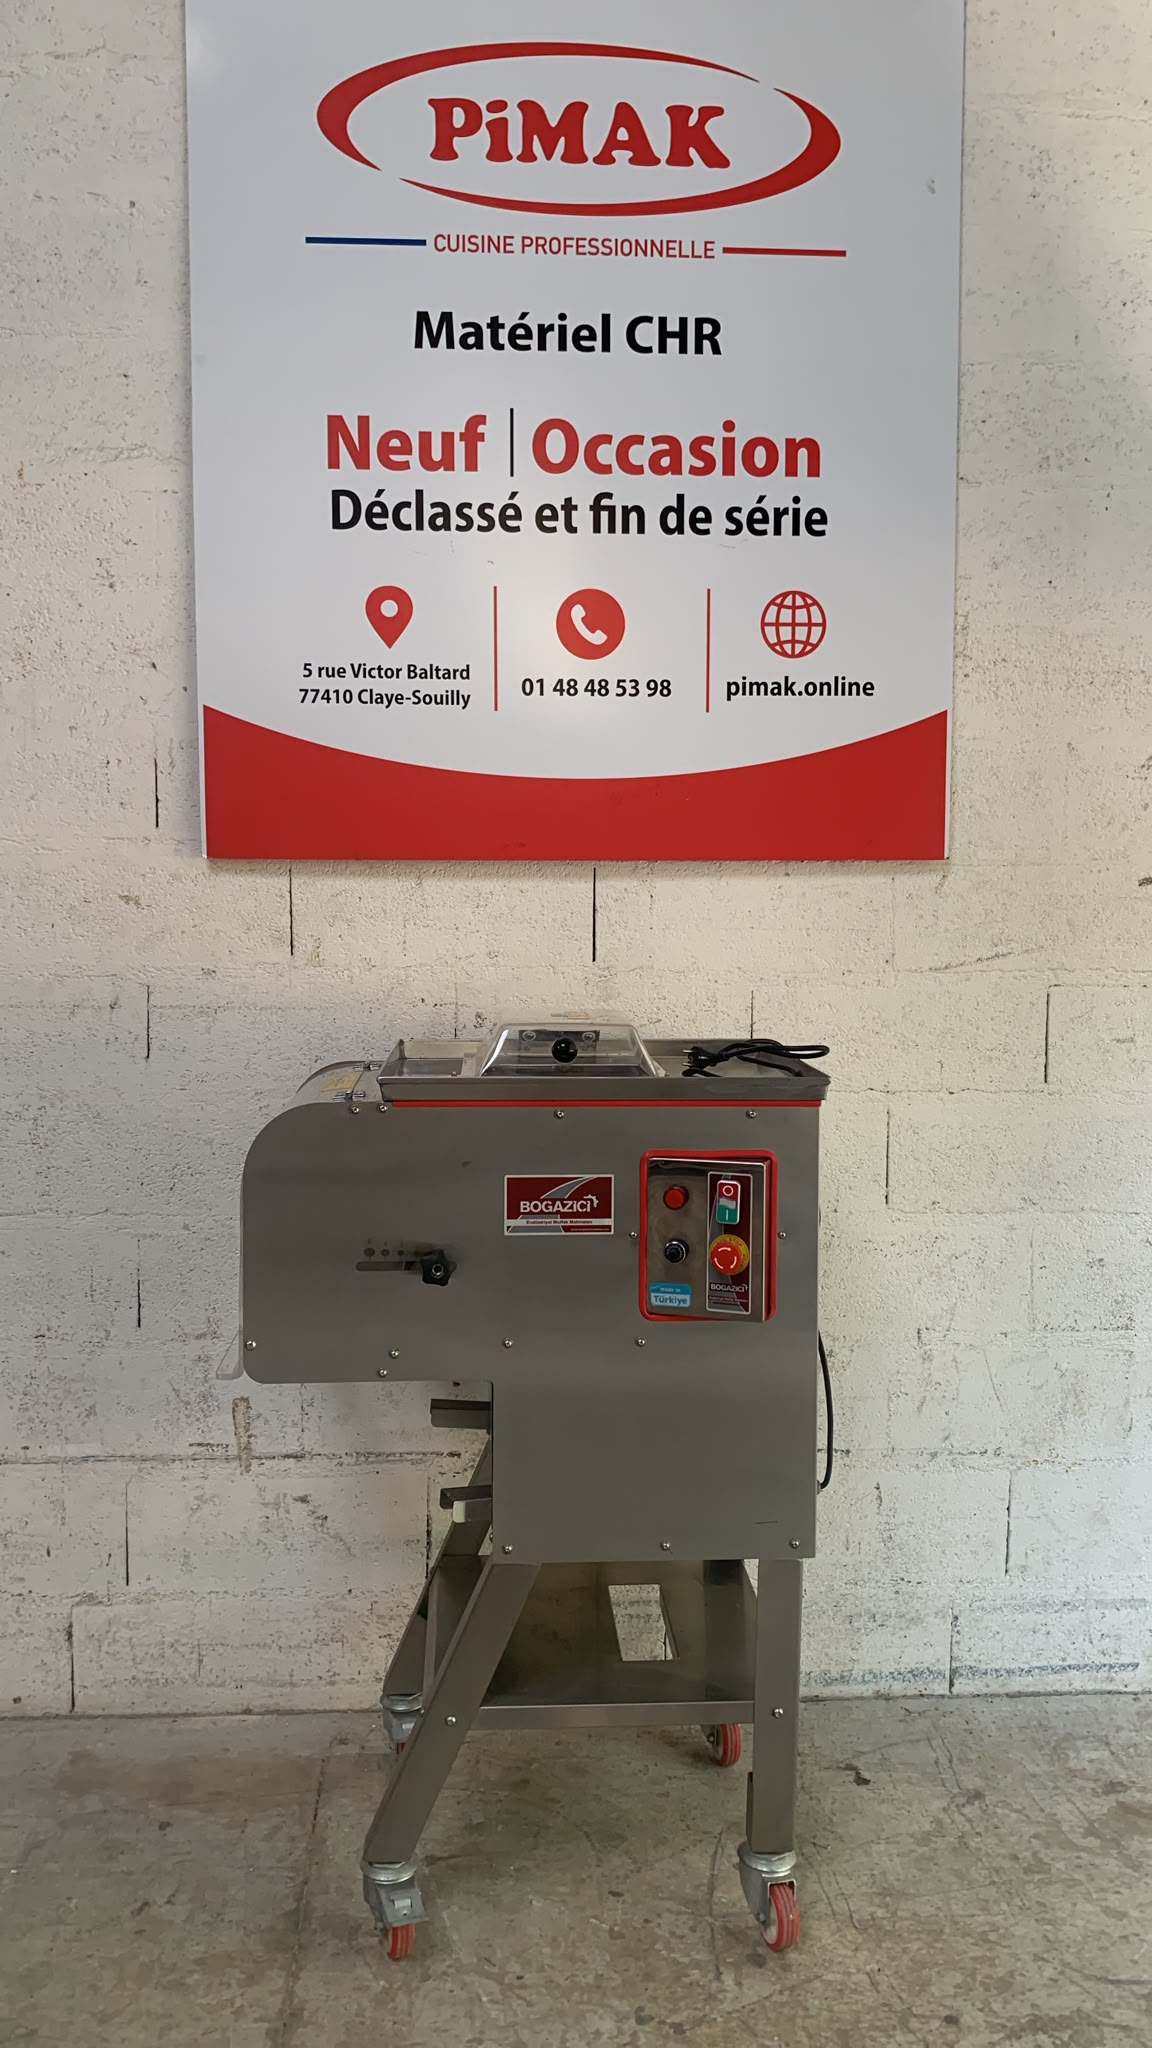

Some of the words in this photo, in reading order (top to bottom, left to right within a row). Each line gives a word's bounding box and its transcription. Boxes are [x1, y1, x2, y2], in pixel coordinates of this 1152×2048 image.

[433, 234, 515, 254] CUISINE
[521, 235, 716, 259] PROFESSIONNELLE
[414, 311, 611, 353] Matériel
[625, 316, 722, 356] CHR
[327, 414, 487, 473] Neuf
[531, 419, 821, 478] Occasion
[331, 489, 523, 533] Déclassé
[534, 497, 579, 534] et
[589, 492, 646, 535] fin
[659, 494, 713, 536] de
[724, 495, 828, 538] série
[302, 663, 313, 678] 5
[317, 667, 347, 679] rue
[350, 663, 403, 680] Victor
[407, 664, 470, 681] Baltard
[298, 688, 353, 705] 77410
[357, 688, 471, 710] Claye-Souilly
[521, 678, 544, 697] 01
[552, 678, 579, 697] 48
[583, 678, 610, 697] 48
[615, 678, 640, 698] 53
[645, 678, 672, 698] 98
[726, 675, 875, 702] pimak.online
[653, 1294, 688, 1305] Türkiye
